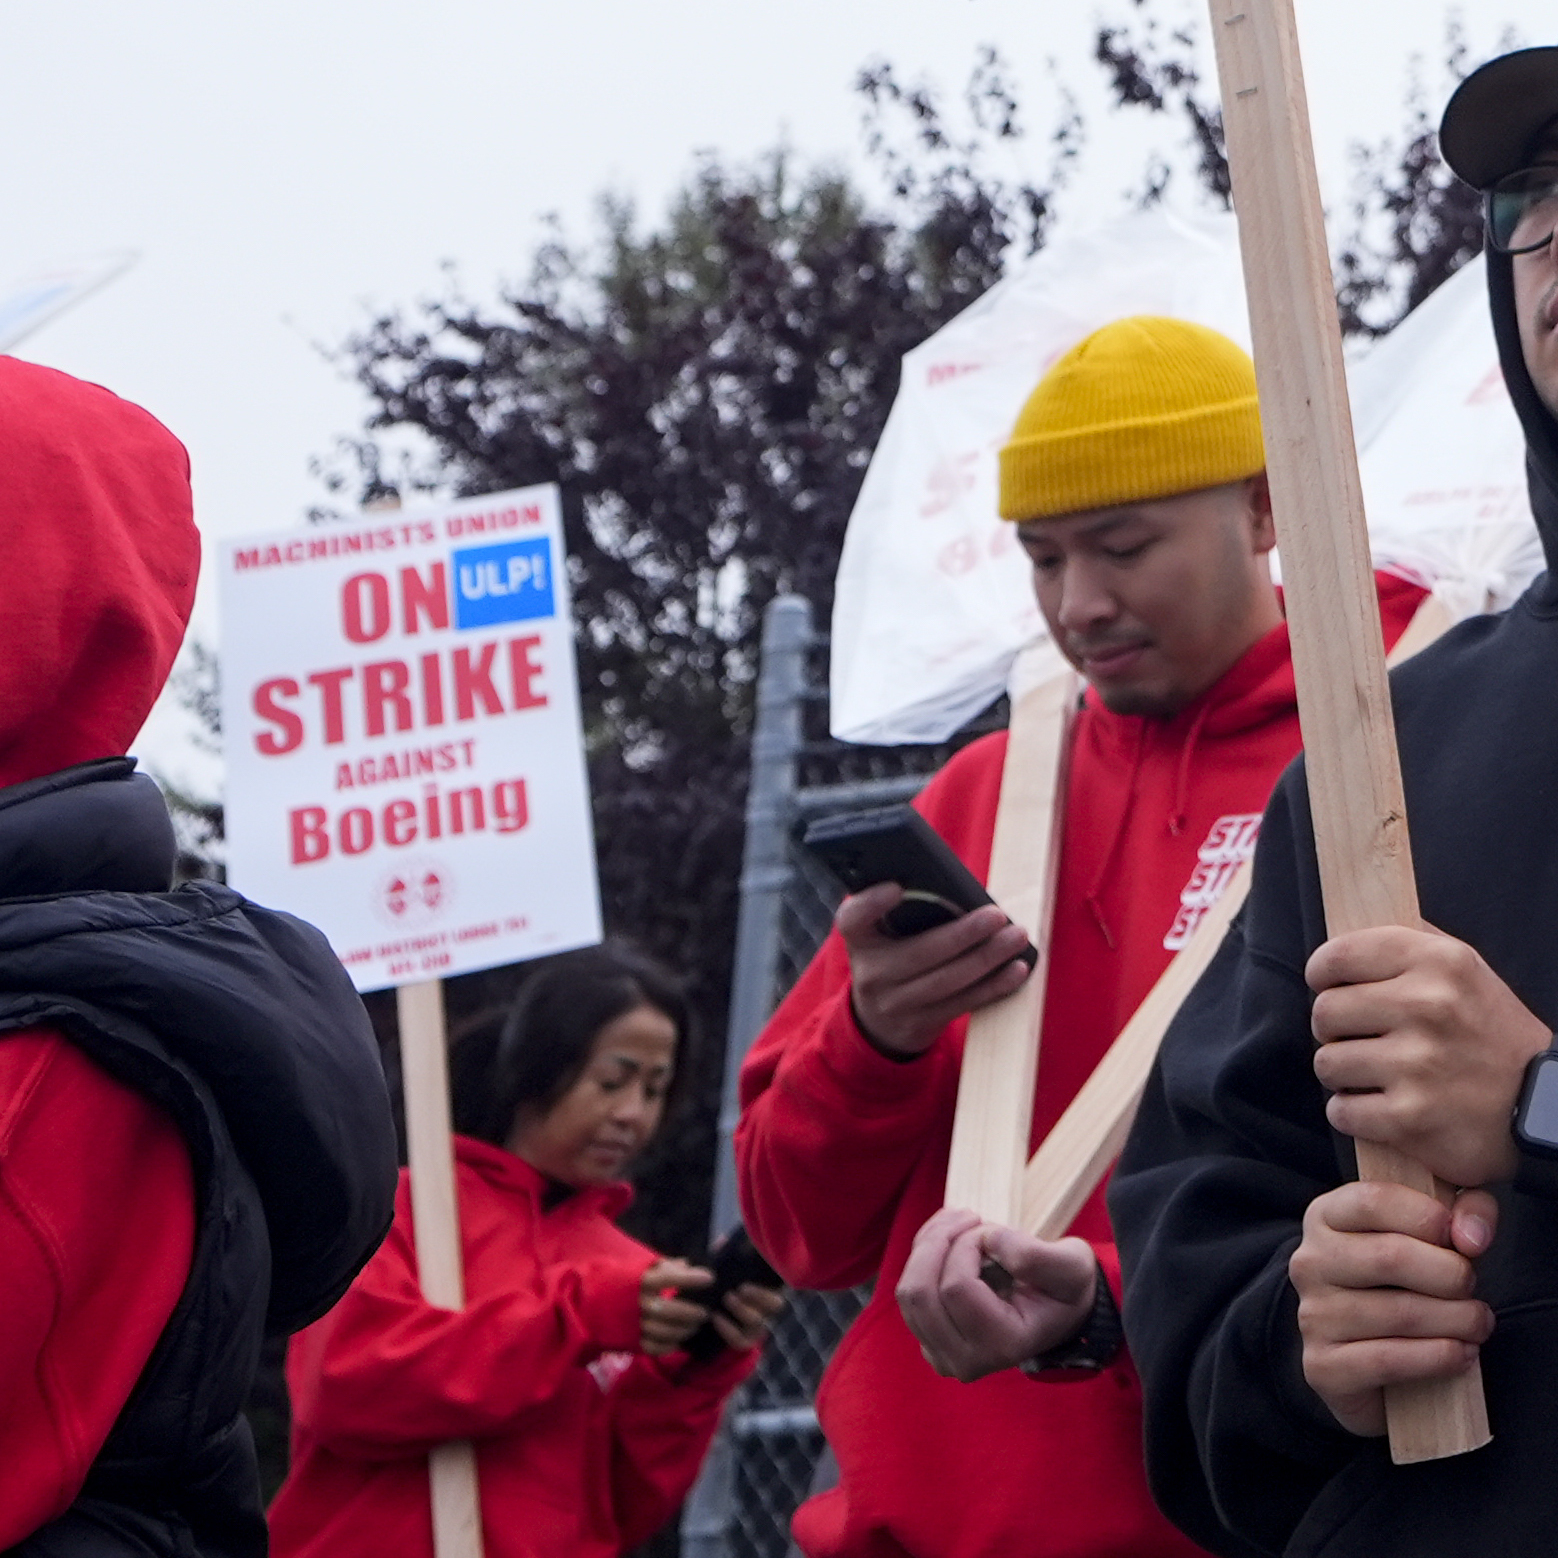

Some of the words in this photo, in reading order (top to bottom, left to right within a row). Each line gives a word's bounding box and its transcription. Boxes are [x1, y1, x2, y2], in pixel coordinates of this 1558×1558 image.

[234, 521, 435, 572] MACHINISTS
[445, 504, 542, 538] UNION
[340, 560, 450, 645] ON
[460, 553, 546, 601] ULP!
[251, 633, 550, 757] STRIKE
[335, 738, 476, 792] AGAINST
[288, 775, 531, 866] Boeing
